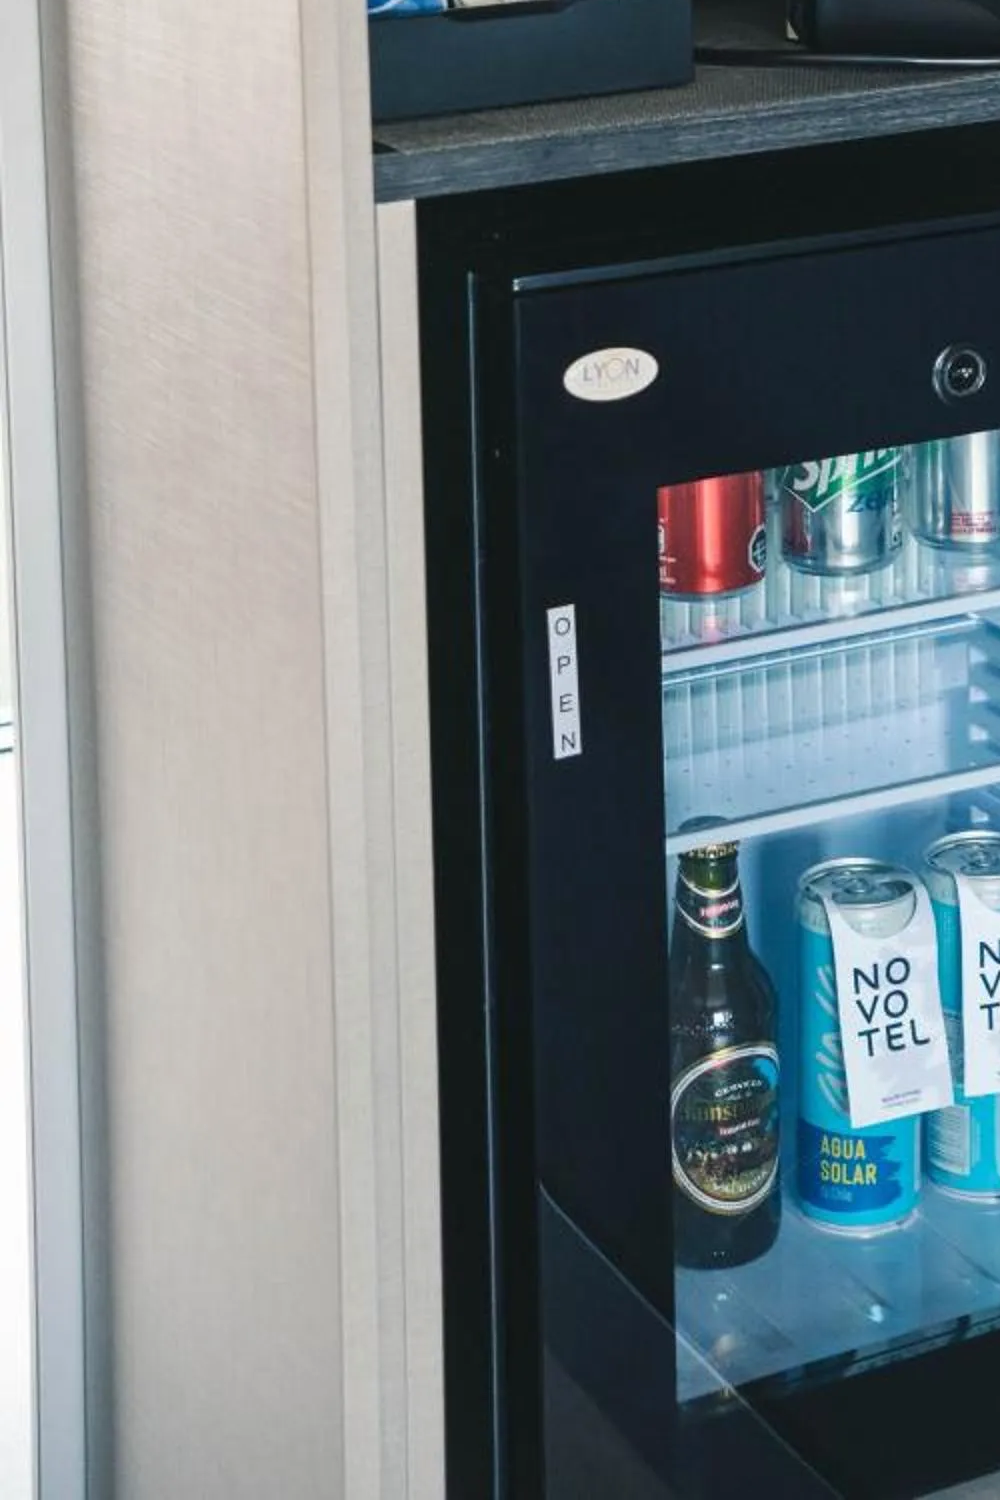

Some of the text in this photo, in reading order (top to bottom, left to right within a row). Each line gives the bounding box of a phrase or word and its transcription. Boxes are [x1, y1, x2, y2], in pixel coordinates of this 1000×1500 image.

[583, 358, 640, 382] LYON
[554, 617, 576, 751] OPEN
[853, 957, 910, 994] NO
[856, 989, 908, 1024] VO
[858, 1019, 930, 1057] TEL
[820, 1137, 866, 1160] AGUA
[820, 1160, 877, 1185] SOLAR
